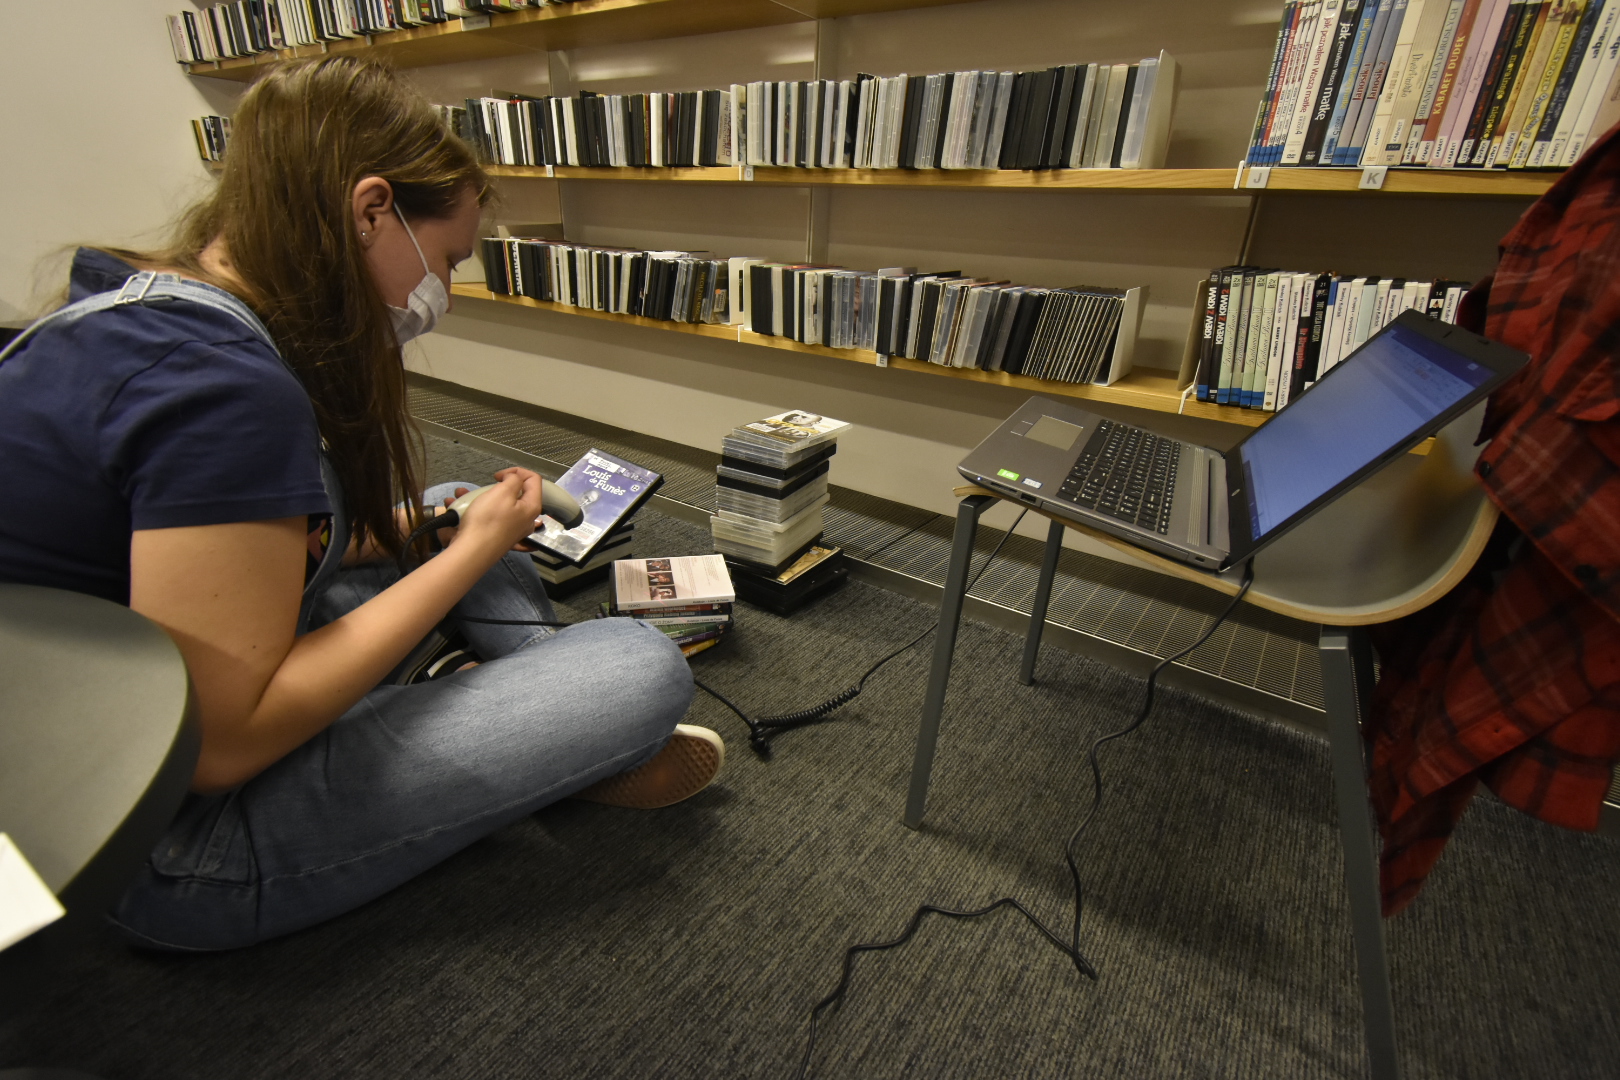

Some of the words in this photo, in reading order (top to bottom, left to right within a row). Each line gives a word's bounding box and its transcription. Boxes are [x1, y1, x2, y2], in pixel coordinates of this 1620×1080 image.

[1323, 17, 1334, 29] jak
[1338, 22, 1354, 40] jak
[1313, 30, 1328, 66] poznałem
[1332, 40, 1345, 69] poznałem
[1352, 67, 1370, 101] Janosik
[1433, 73, 1453, 115] KABARET
[1448, 35, 1466, 69] DUDEK
[1299, 91, 1312, 113] matkę
[1314, 87, 1334, 121] matkę
[1253, 173, 1262, 184] J
[1366, 172, 1380, 185] K
[1207, 286, 1218, 309] KRWI
[1218, 294, 1229, 316] KRWI
[1203, 315, 1214, 339] KREW
[1215, 321, 1226, 345] KREW
[583, 465, 612, 481] Louis
[594, 479, 626, 496] Funès
